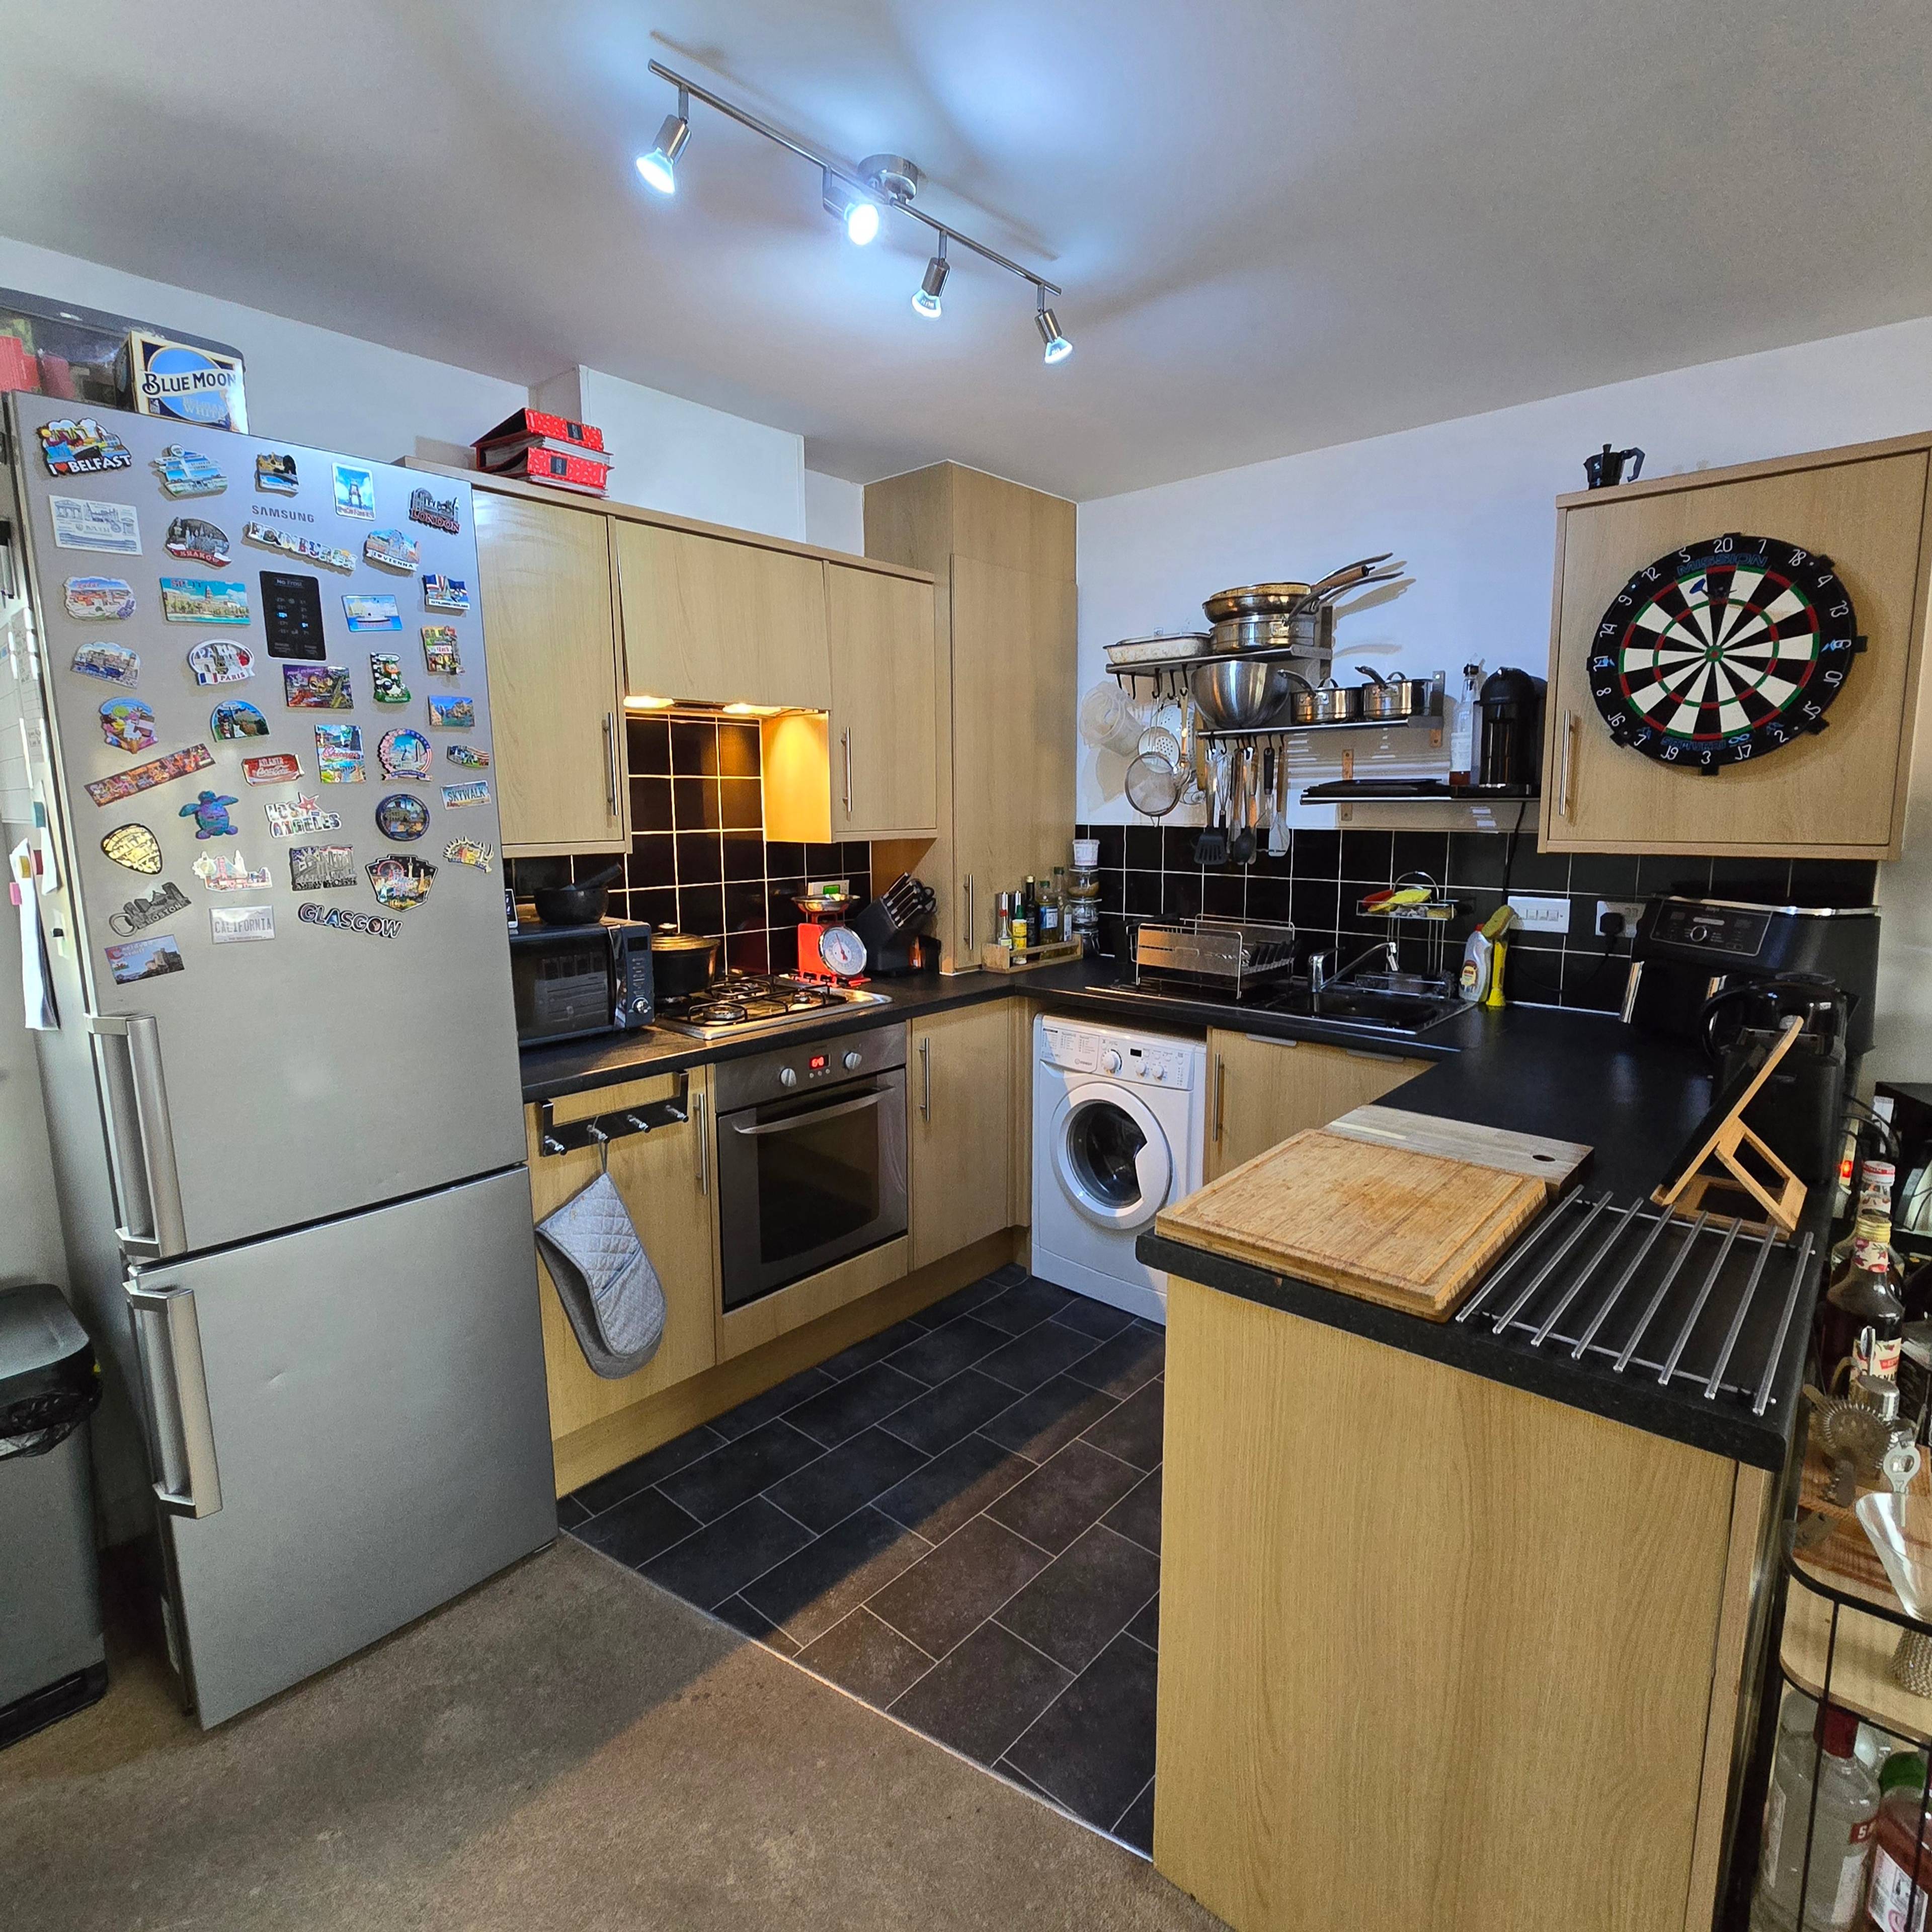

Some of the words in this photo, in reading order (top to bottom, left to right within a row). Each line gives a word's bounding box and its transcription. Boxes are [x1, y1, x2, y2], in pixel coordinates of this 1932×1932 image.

[142, 372, 189, 395] BLUE
[193, 369, 235, 389] MOON
[49, 464, 57, 475] I
[69, 454, 131, 473] BELFAST
[252, 505, 314, 523] SAMSUNG
[410, 509, 460, 532] LONDON
[1714, 538, 1733, 552] 20
[180, 550, 219, 562] KRAKOW
[383, 556, 414, 569] VIENNA
[1679, 547, 1690, 562] 5
[1677, 553, 1768, 576] MISSION
[1642, 567, 1661, 582] 12
[1817, 574, 1833, 587] 4
[171, 579, 202, 589] SPLIT
[1619, 595, 1632, 605] 9
[1830, 600, 1848, 617] 13
[1600, 623, 1617, 637] 14
[220, 672, 245, 681] PARIS
[1824, 671, 1843, 688] 10
[1597, 687, 1611, 696] 8
[1803, 701, 1821, 719] 15
[1608, 712, 1625, 728] 16
[1634, 735, 1647, 746] 7
[1775, 731, 1789, 743] 2
[1661, 746, 1678, 760] 19
[1701, 751, 1710, 764] 3
[1735, 745, 1751, 761] 17
[447, 786, 485, 802] SKYWALK
[266, 802, 298, 821] LOS
[272, 814, 340, 837] ANGELES
[145, 903, 182, 925] BOSTON
[300, 905, 402, 937] GLASGOW
[215, 918, 272, 934] CALIFORNIA
